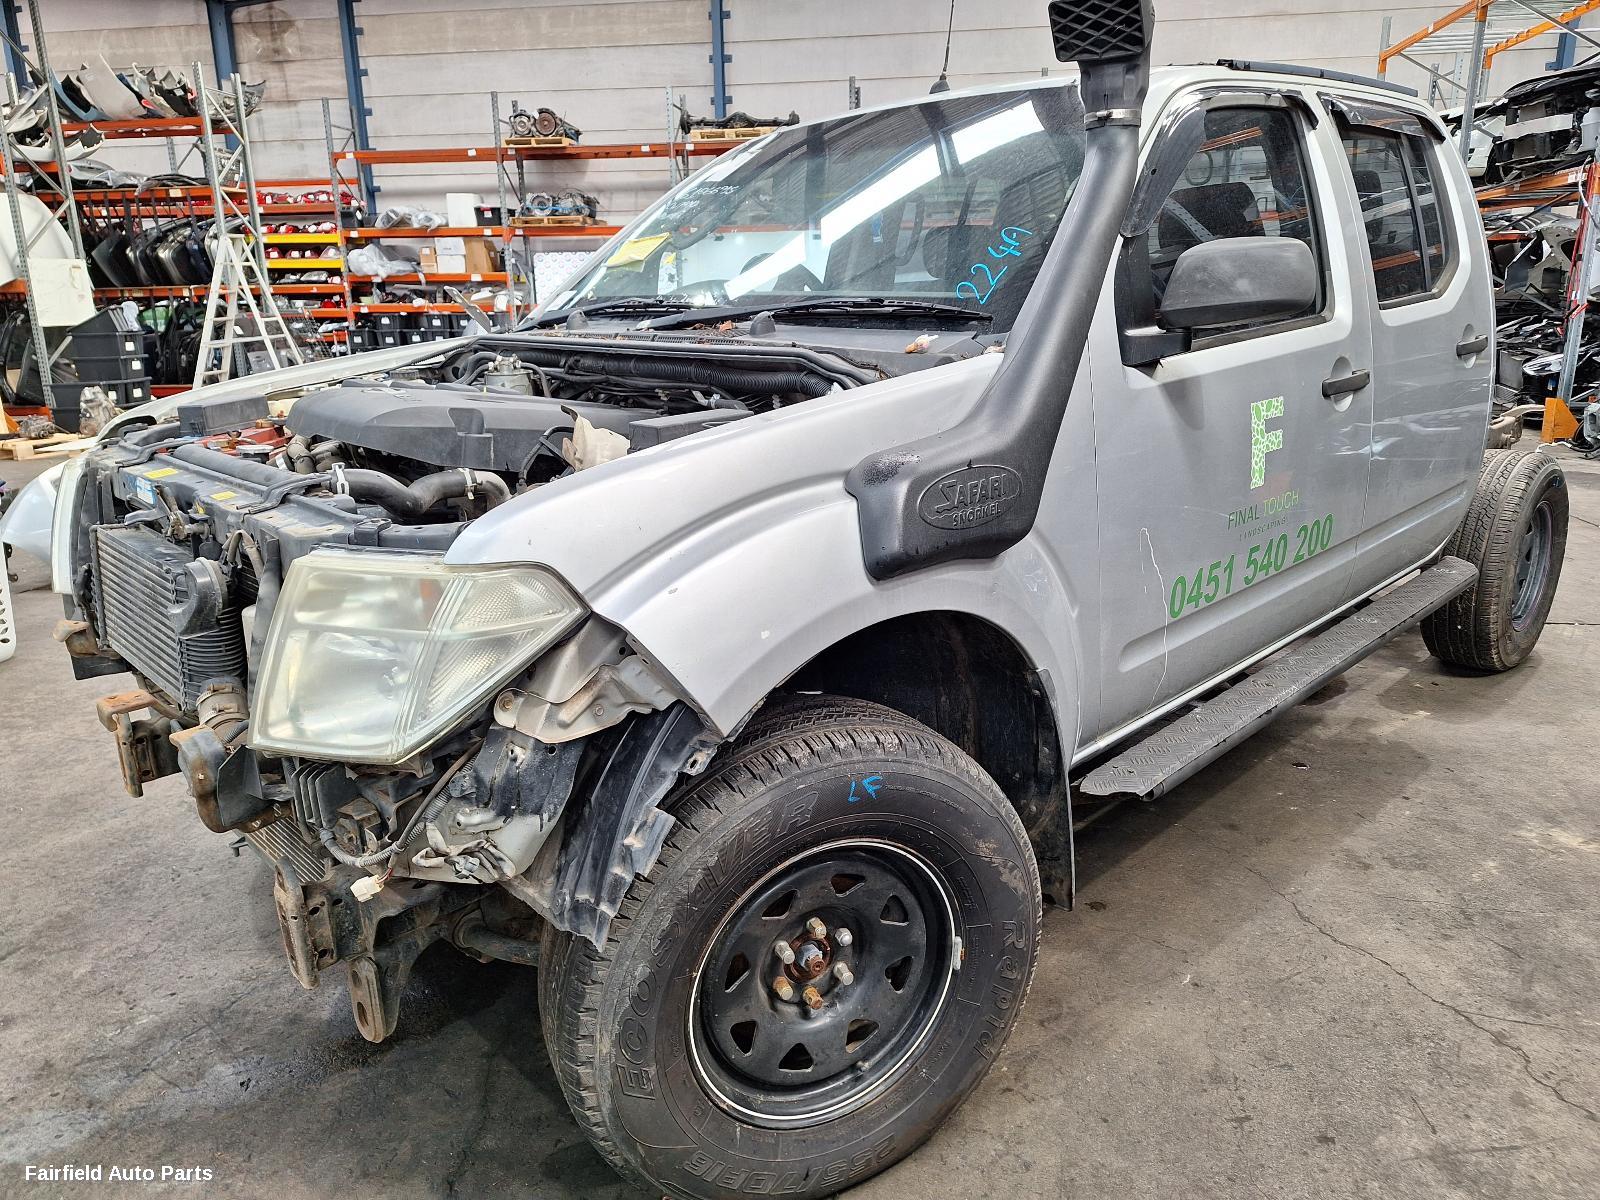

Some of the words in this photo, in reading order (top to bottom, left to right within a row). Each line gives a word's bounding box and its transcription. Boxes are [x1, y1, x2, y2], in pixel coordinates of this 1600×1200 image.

[1250, 395, 1285, 490] F
[934, 473, 1008, 514] SAFARI
[952, 502, 1002, 527] SNORKEL
[1227, 503, 1261, 531] FINAL
[1263, 488, 1300, 517] TOUCH
[1169, 554, 1236, 619] 0451
[1243, 532, 1289, 586] 540
[1292, 512, 1335, 565] 200
[847, 775, 883, 804] LF
[973, 918, 1027, 1061] Rapid
[682, 1131, 898, 1196] 255/70R16
